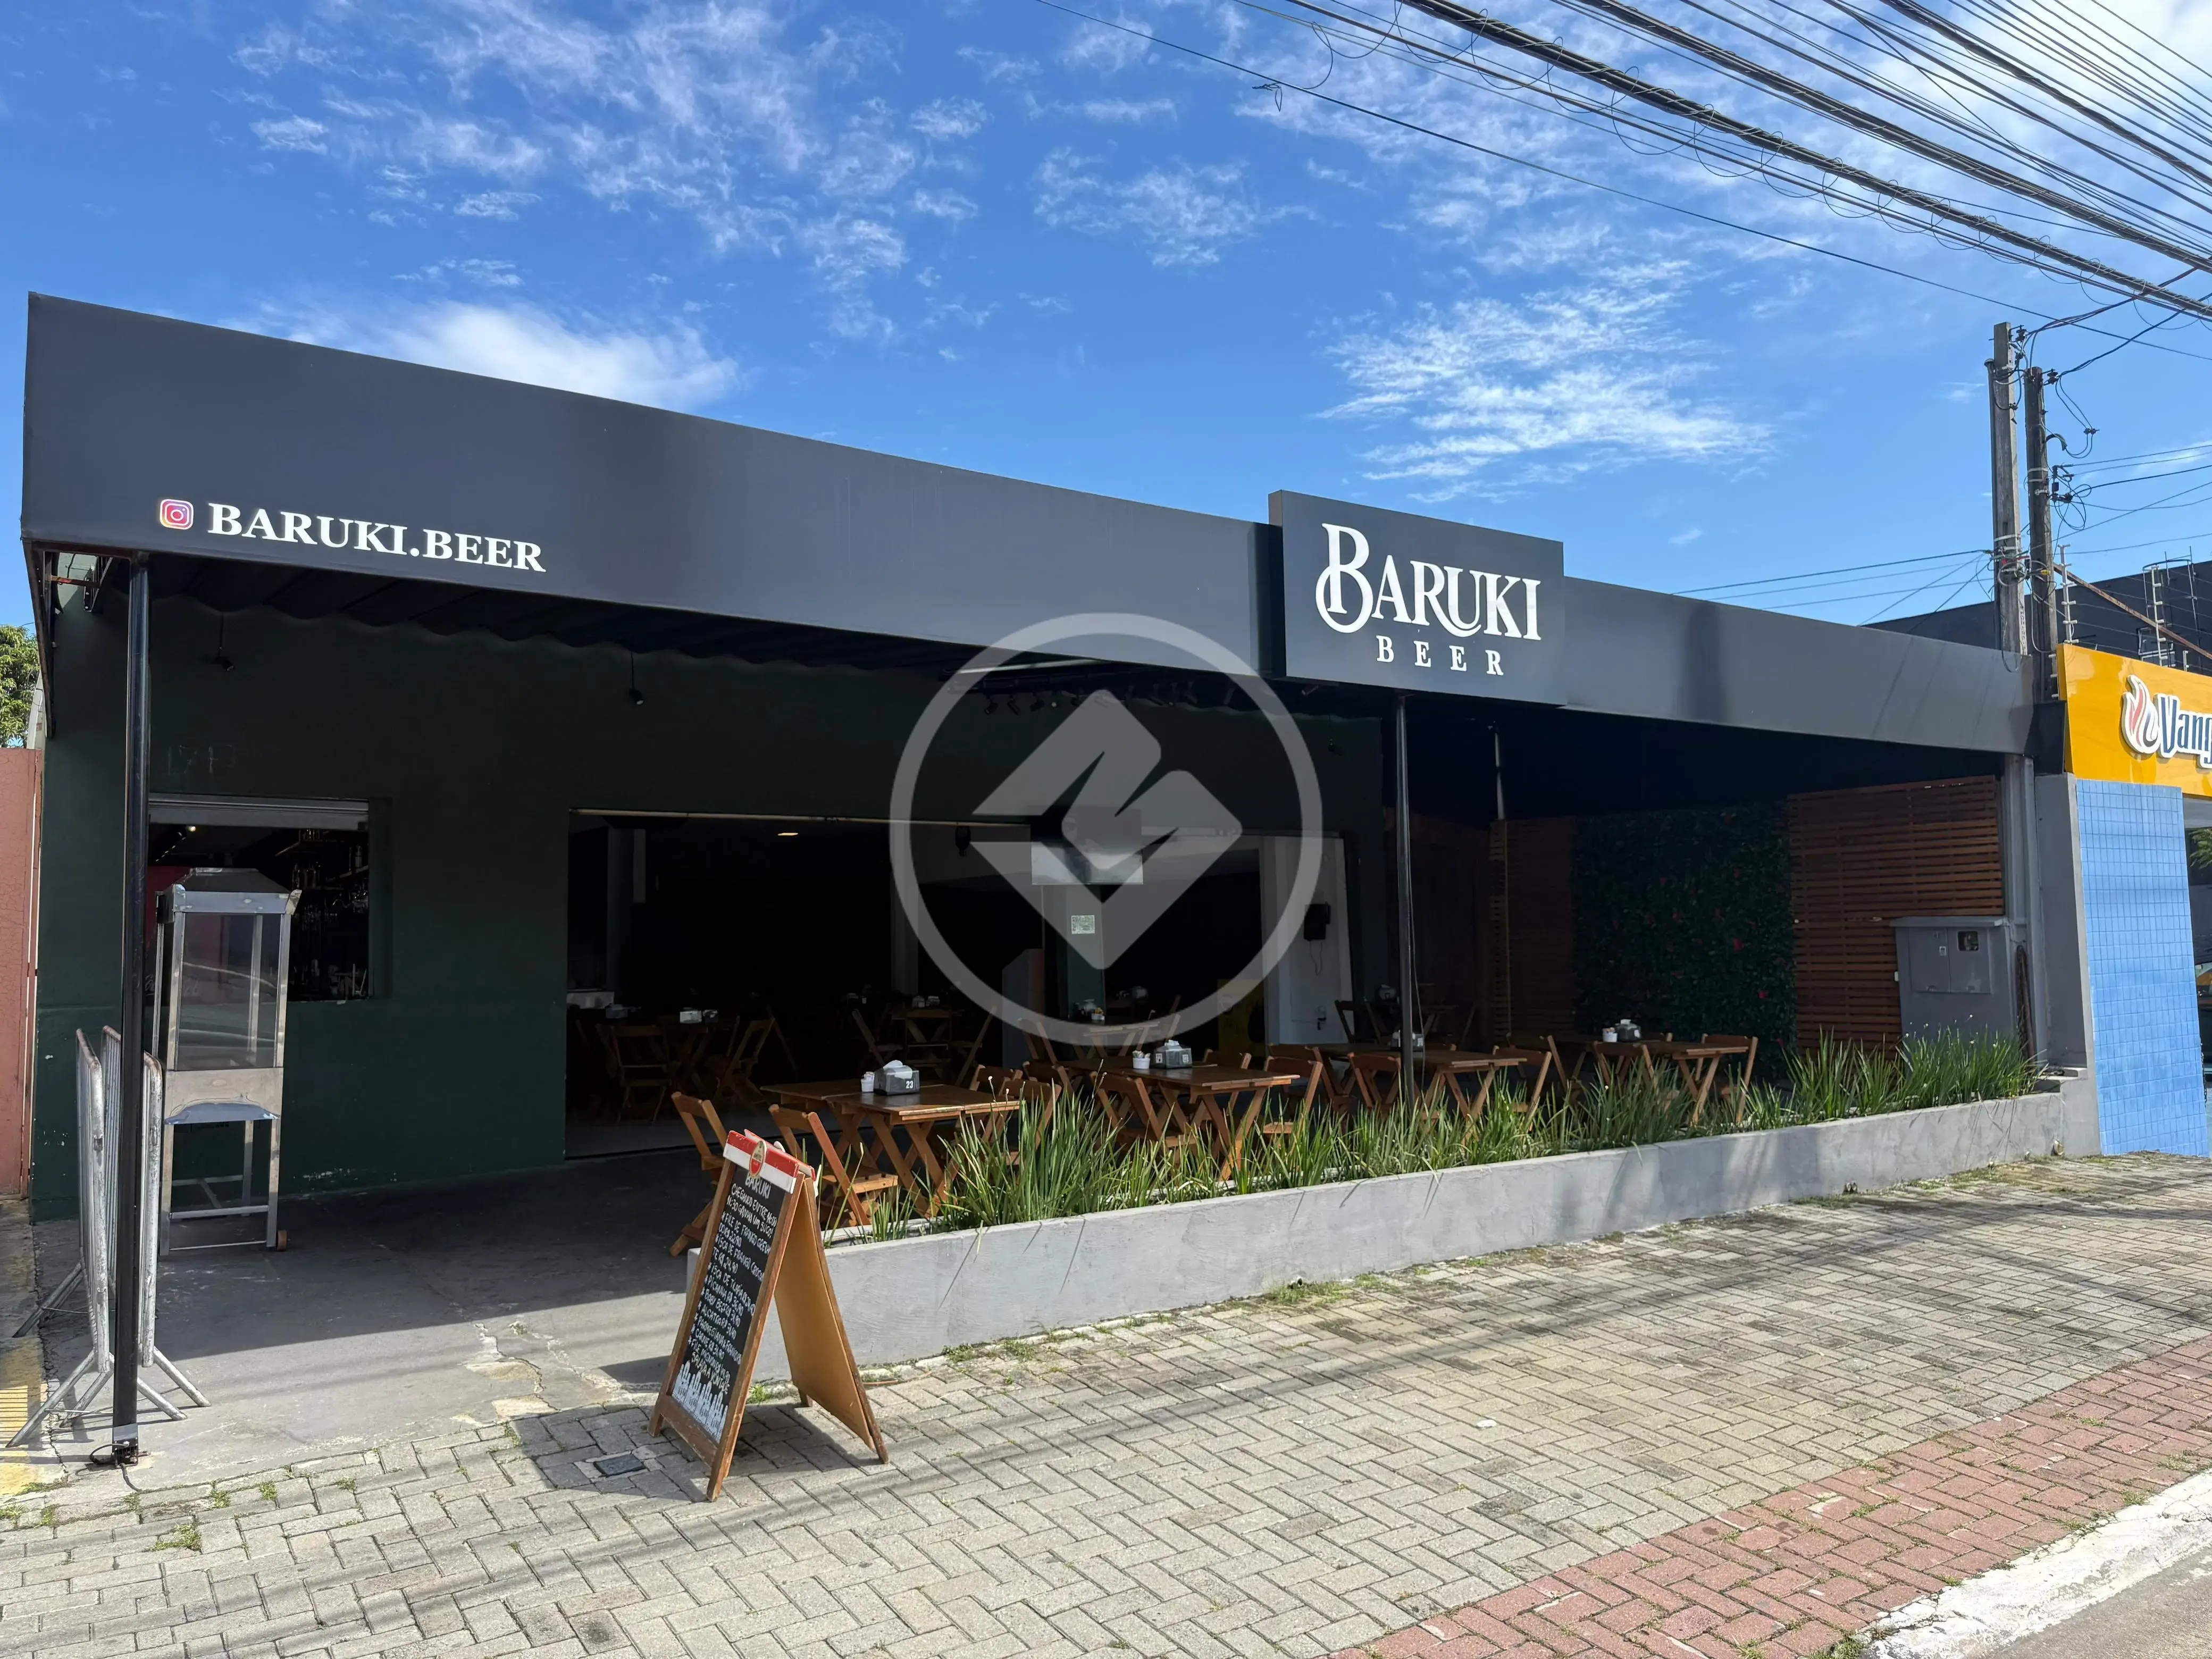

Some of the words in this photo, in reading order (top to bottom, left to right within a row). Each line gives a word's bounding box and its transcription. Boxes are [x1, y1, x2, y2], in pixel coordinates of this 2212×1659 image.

[208, 502, 546, 572] BARUKI.BEER
[1316, 523, 1541, 641] BARUKI
[1376, 635, 1504, 675] BEER
[906, 1080, 914, 1089] 23
